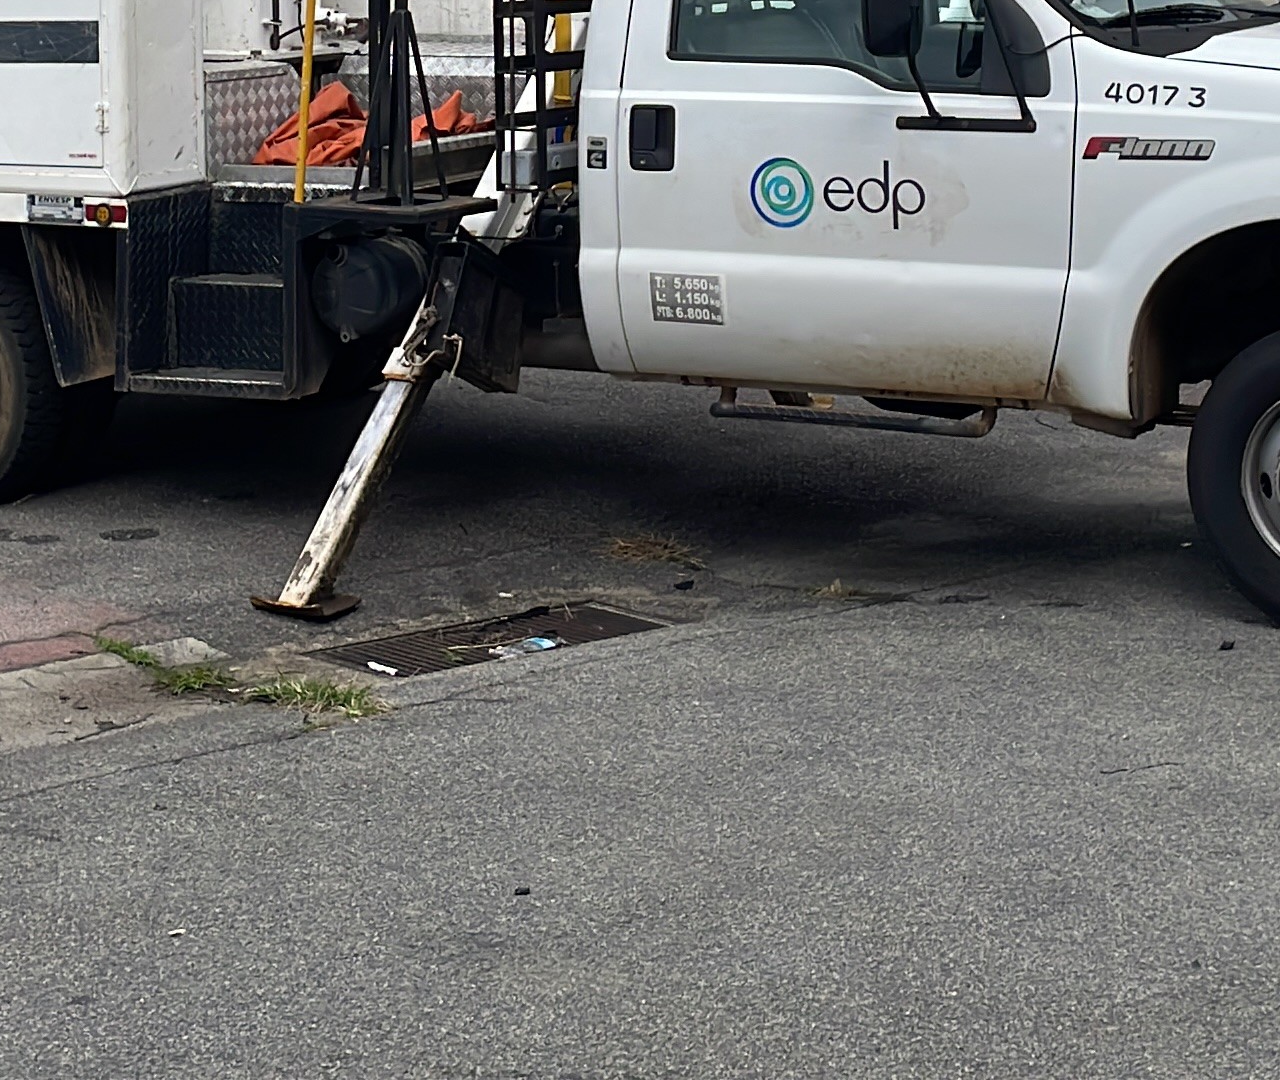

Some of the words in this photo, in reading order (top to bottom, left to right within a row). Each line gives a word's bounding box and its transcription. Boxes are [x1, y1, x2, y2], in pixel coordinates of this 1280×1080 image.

[1105, 82, 1179, 106] 4017
[1188, 87, 1207, 108] 3
[823, 159, 926, 230] edp
